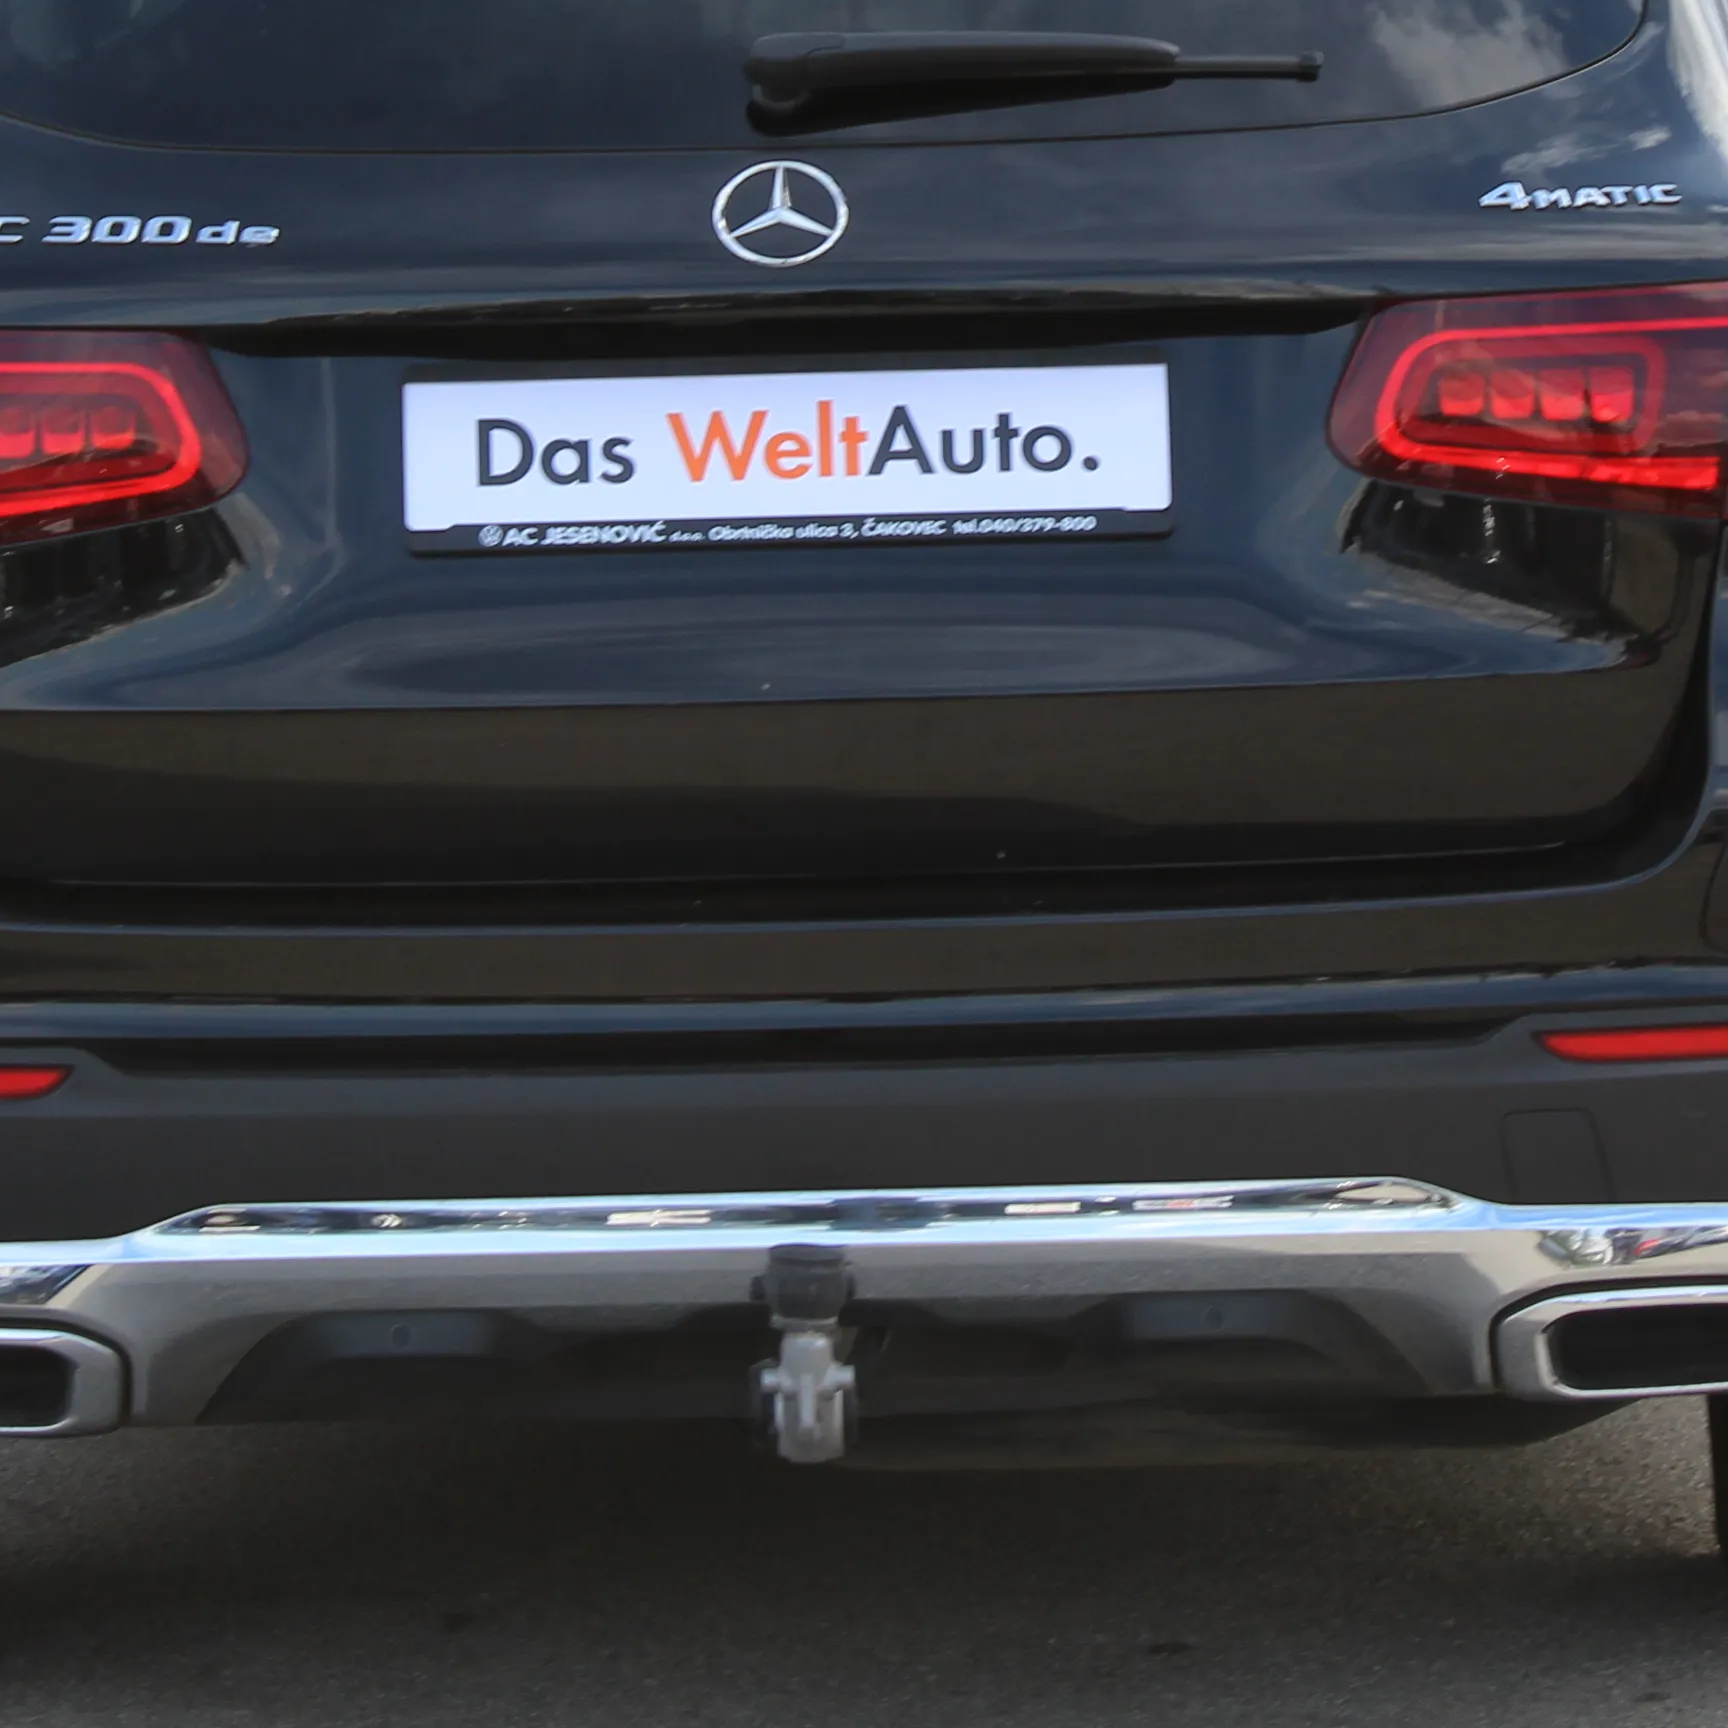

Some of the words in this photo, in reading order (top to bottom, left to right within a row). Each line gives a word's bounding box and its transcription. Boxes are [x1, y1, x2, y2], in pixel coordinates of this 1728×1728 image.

[1479, 180, 1683, 210] 4MATIC
[477, 418, 635, 487] Das
[669, 401, 1099, 481] WeltAuto.
[502, 526, 539, 547] AC
[541, 520, 668, 546] JESENOVIĆ
[860, 516, 947, 537] ČAKOVEC
